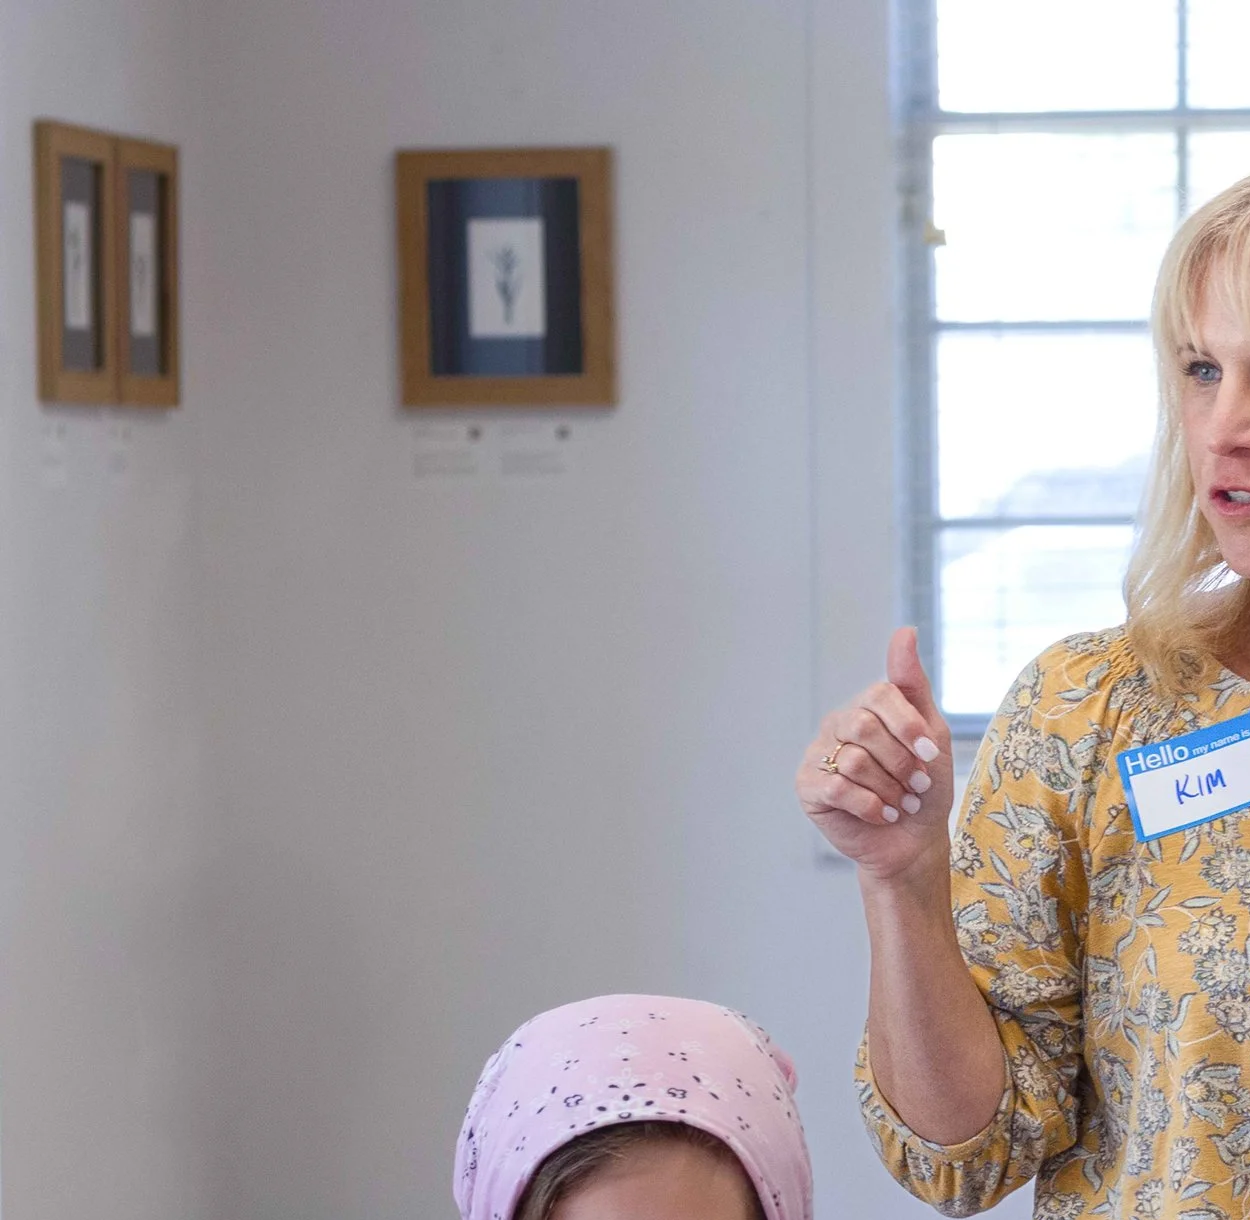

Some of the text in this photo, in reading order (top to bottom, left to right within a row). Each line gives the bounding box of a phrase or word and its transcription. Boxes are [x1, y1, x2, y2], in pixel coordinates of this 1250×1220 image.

[1125, 729, 1250, 774] Hello my name is
[1175, 768, 1227, 804] KIM
